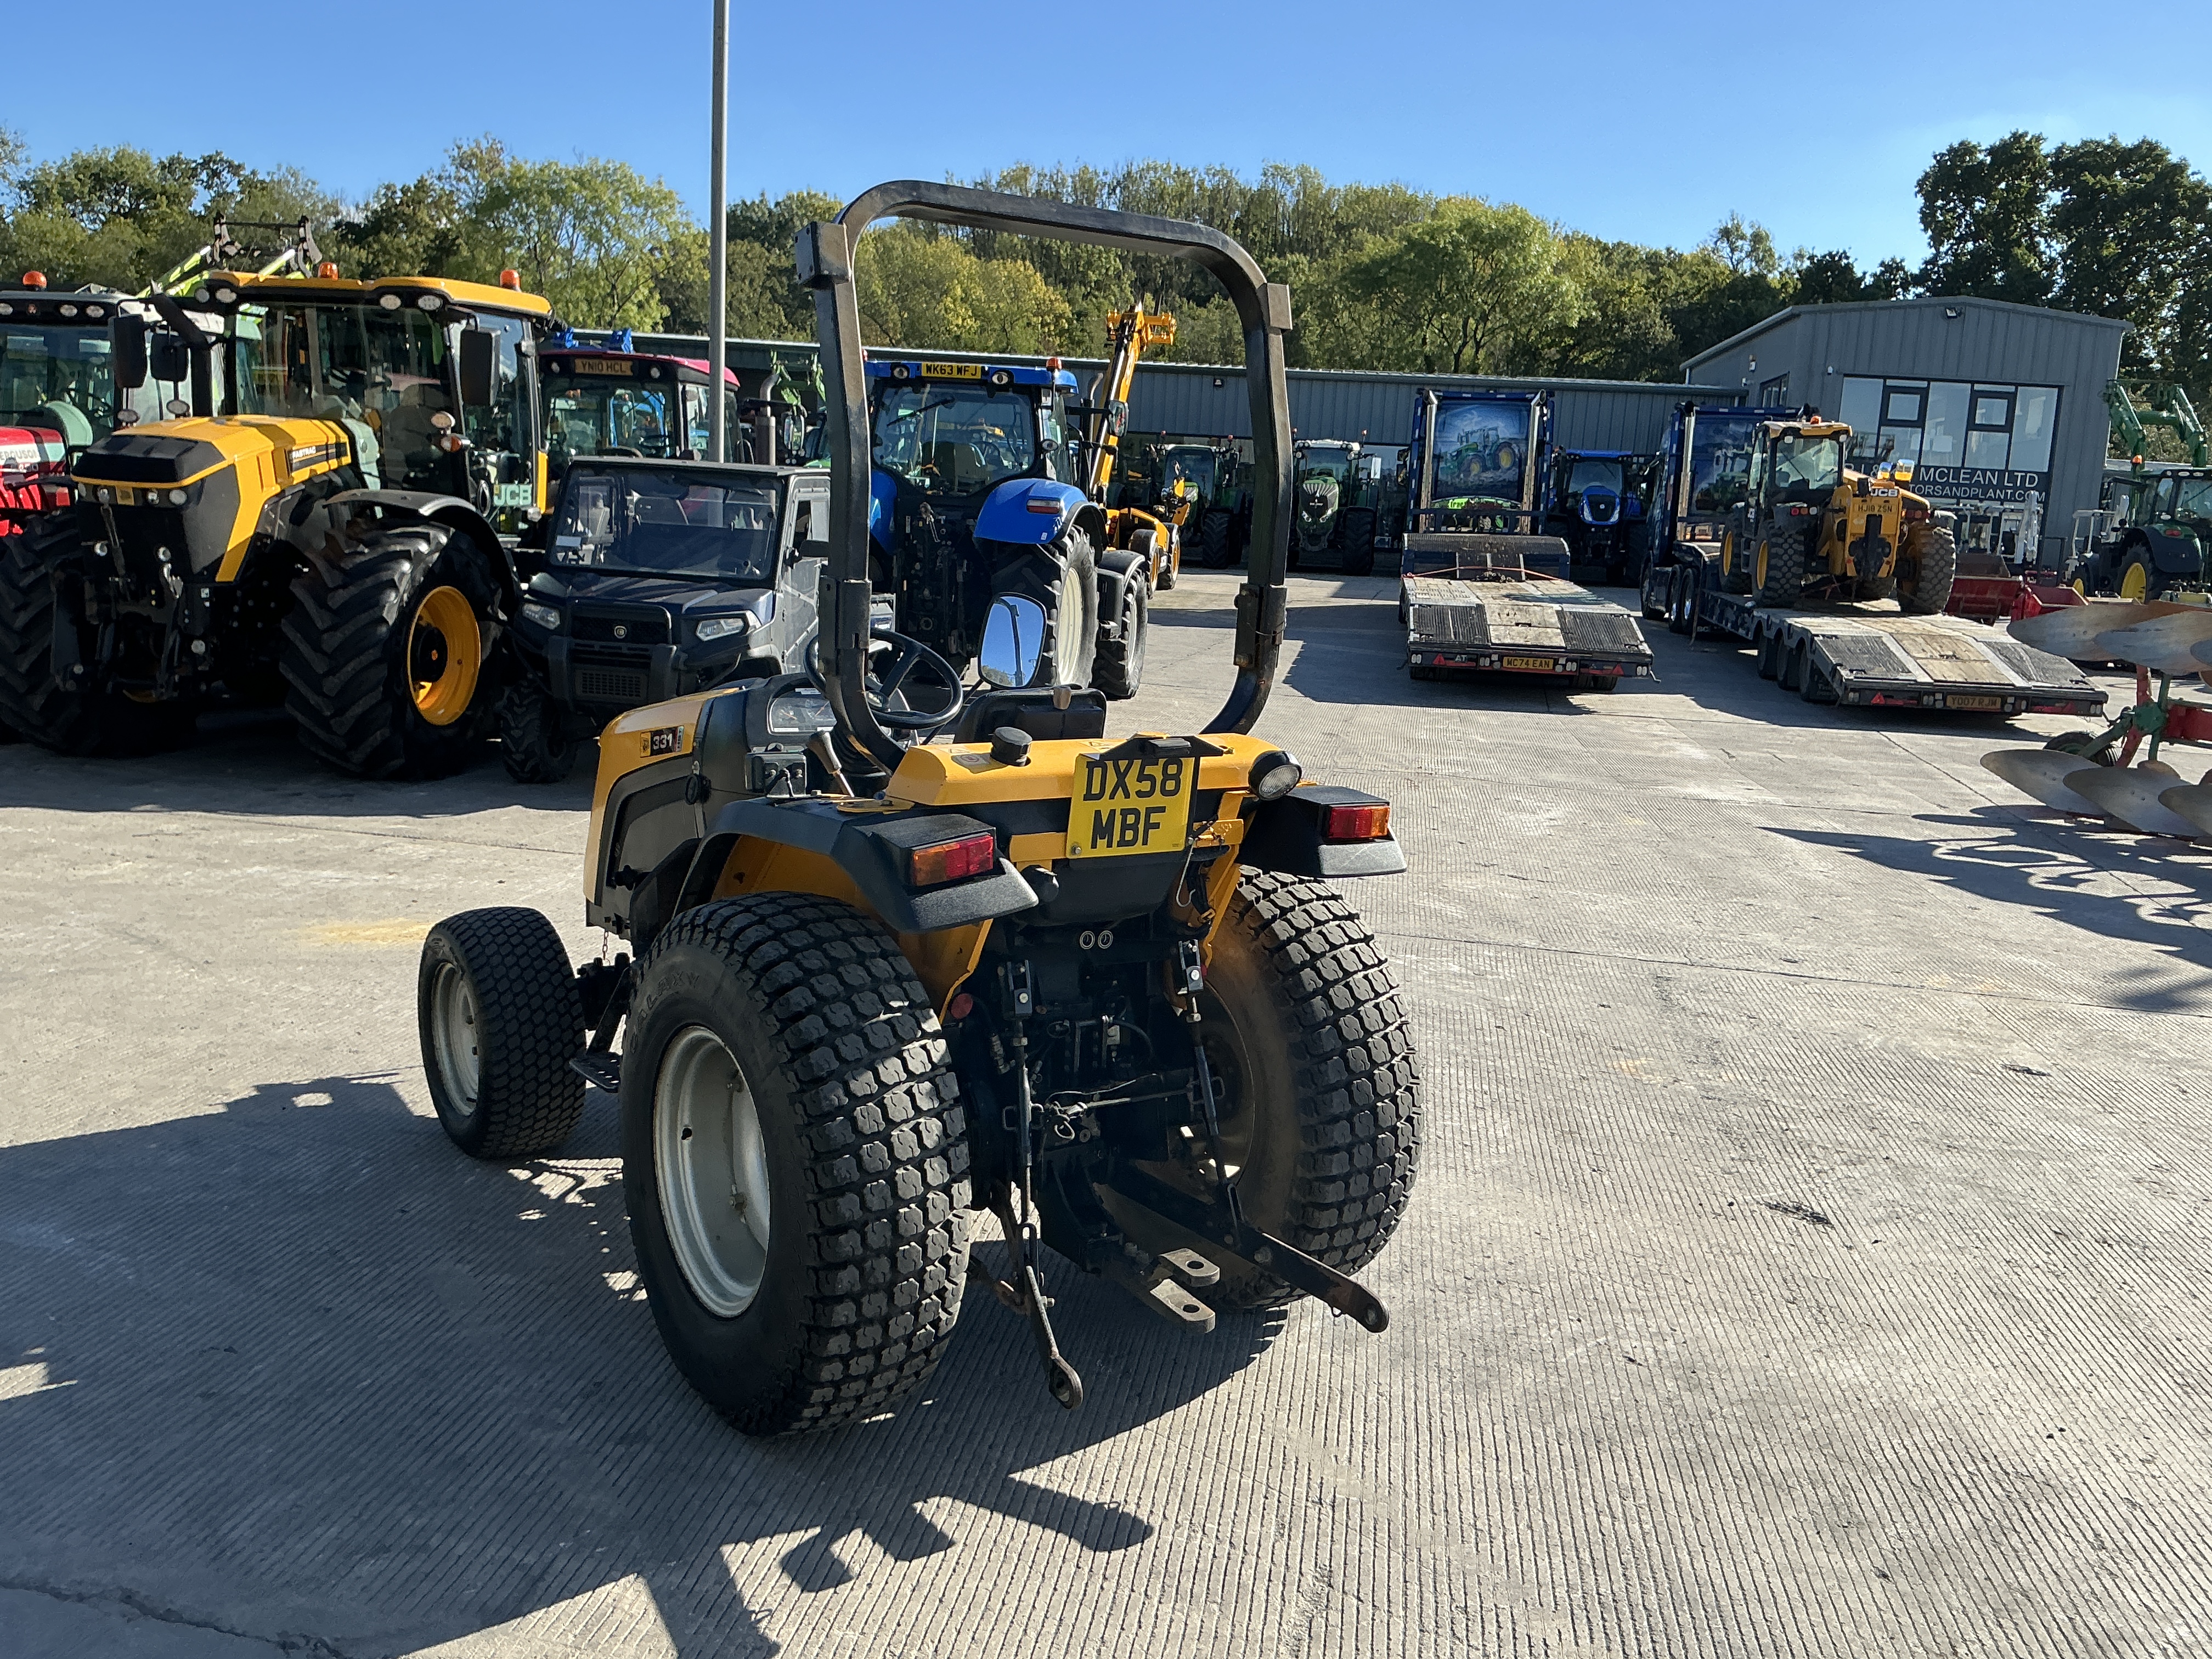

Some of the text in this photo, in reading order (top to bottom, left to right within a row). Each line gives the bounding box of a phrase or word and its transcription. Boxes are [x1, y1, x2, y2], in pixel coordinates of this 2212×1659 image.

[582, 362, 626, 374] YN10 HCL
[926, 363, 953, 375] WK63
[1919, 467, 1999, 486] MCLEAN
[2004, 471, 2039, 488] LTD
[493, 484, 532, 505] JCB
[1870, 488, 1898, 497] JCB
[653, 733, 673, 751] 331
[1083, 758, 1183, 801] DX58
[1091, 805, 1167, 849] MBF
